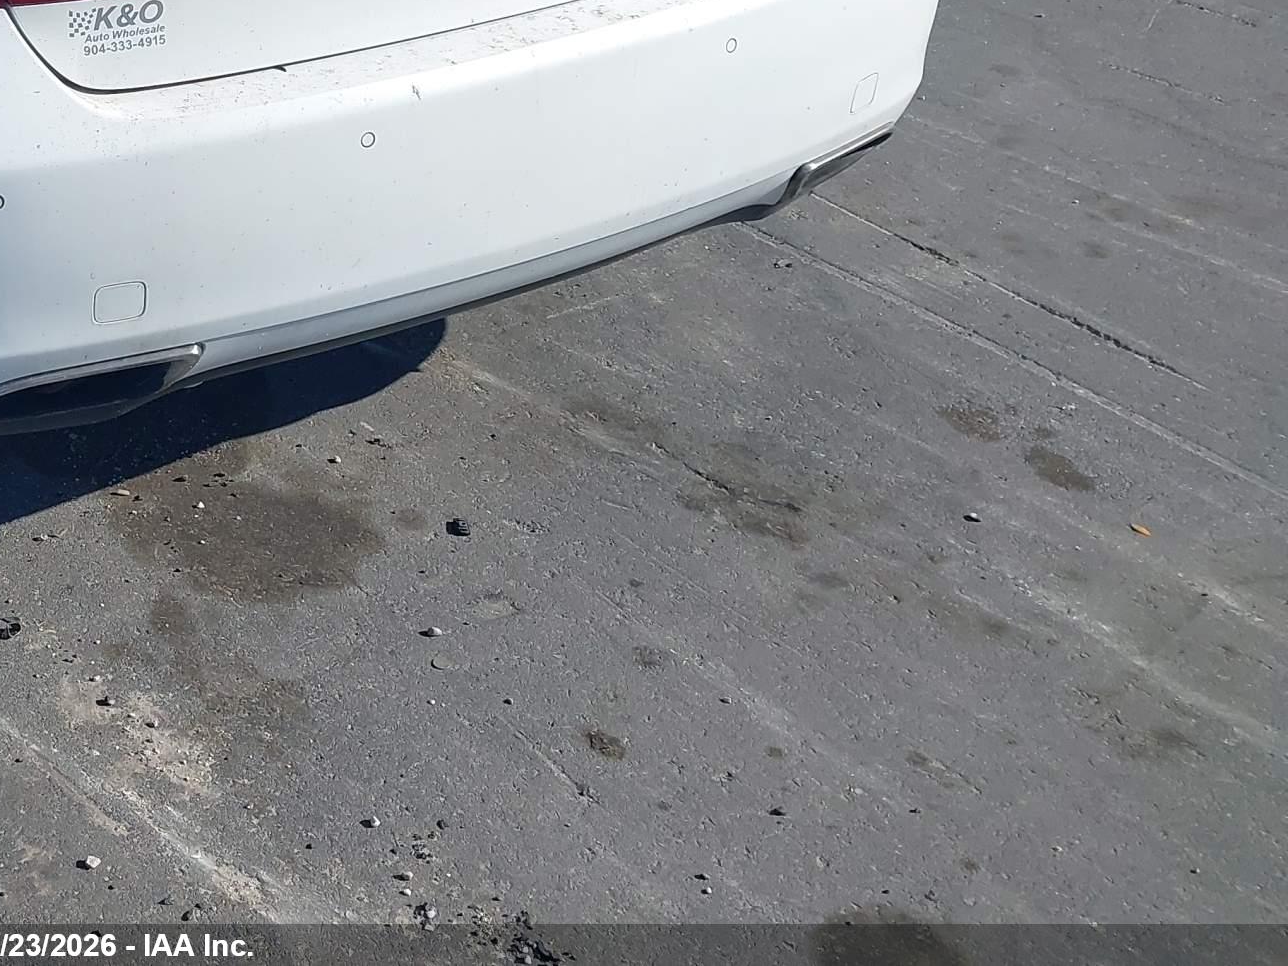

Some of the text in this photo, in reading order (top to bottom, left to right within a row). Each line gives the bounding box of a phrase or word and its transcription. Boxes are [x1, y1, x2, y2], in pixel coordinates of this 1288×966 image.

[93, 0, 164, 31] K&O
[84, 23, 166, 44] Auto Wholesale
[83, 34, 166, 56] 904-333-4915
